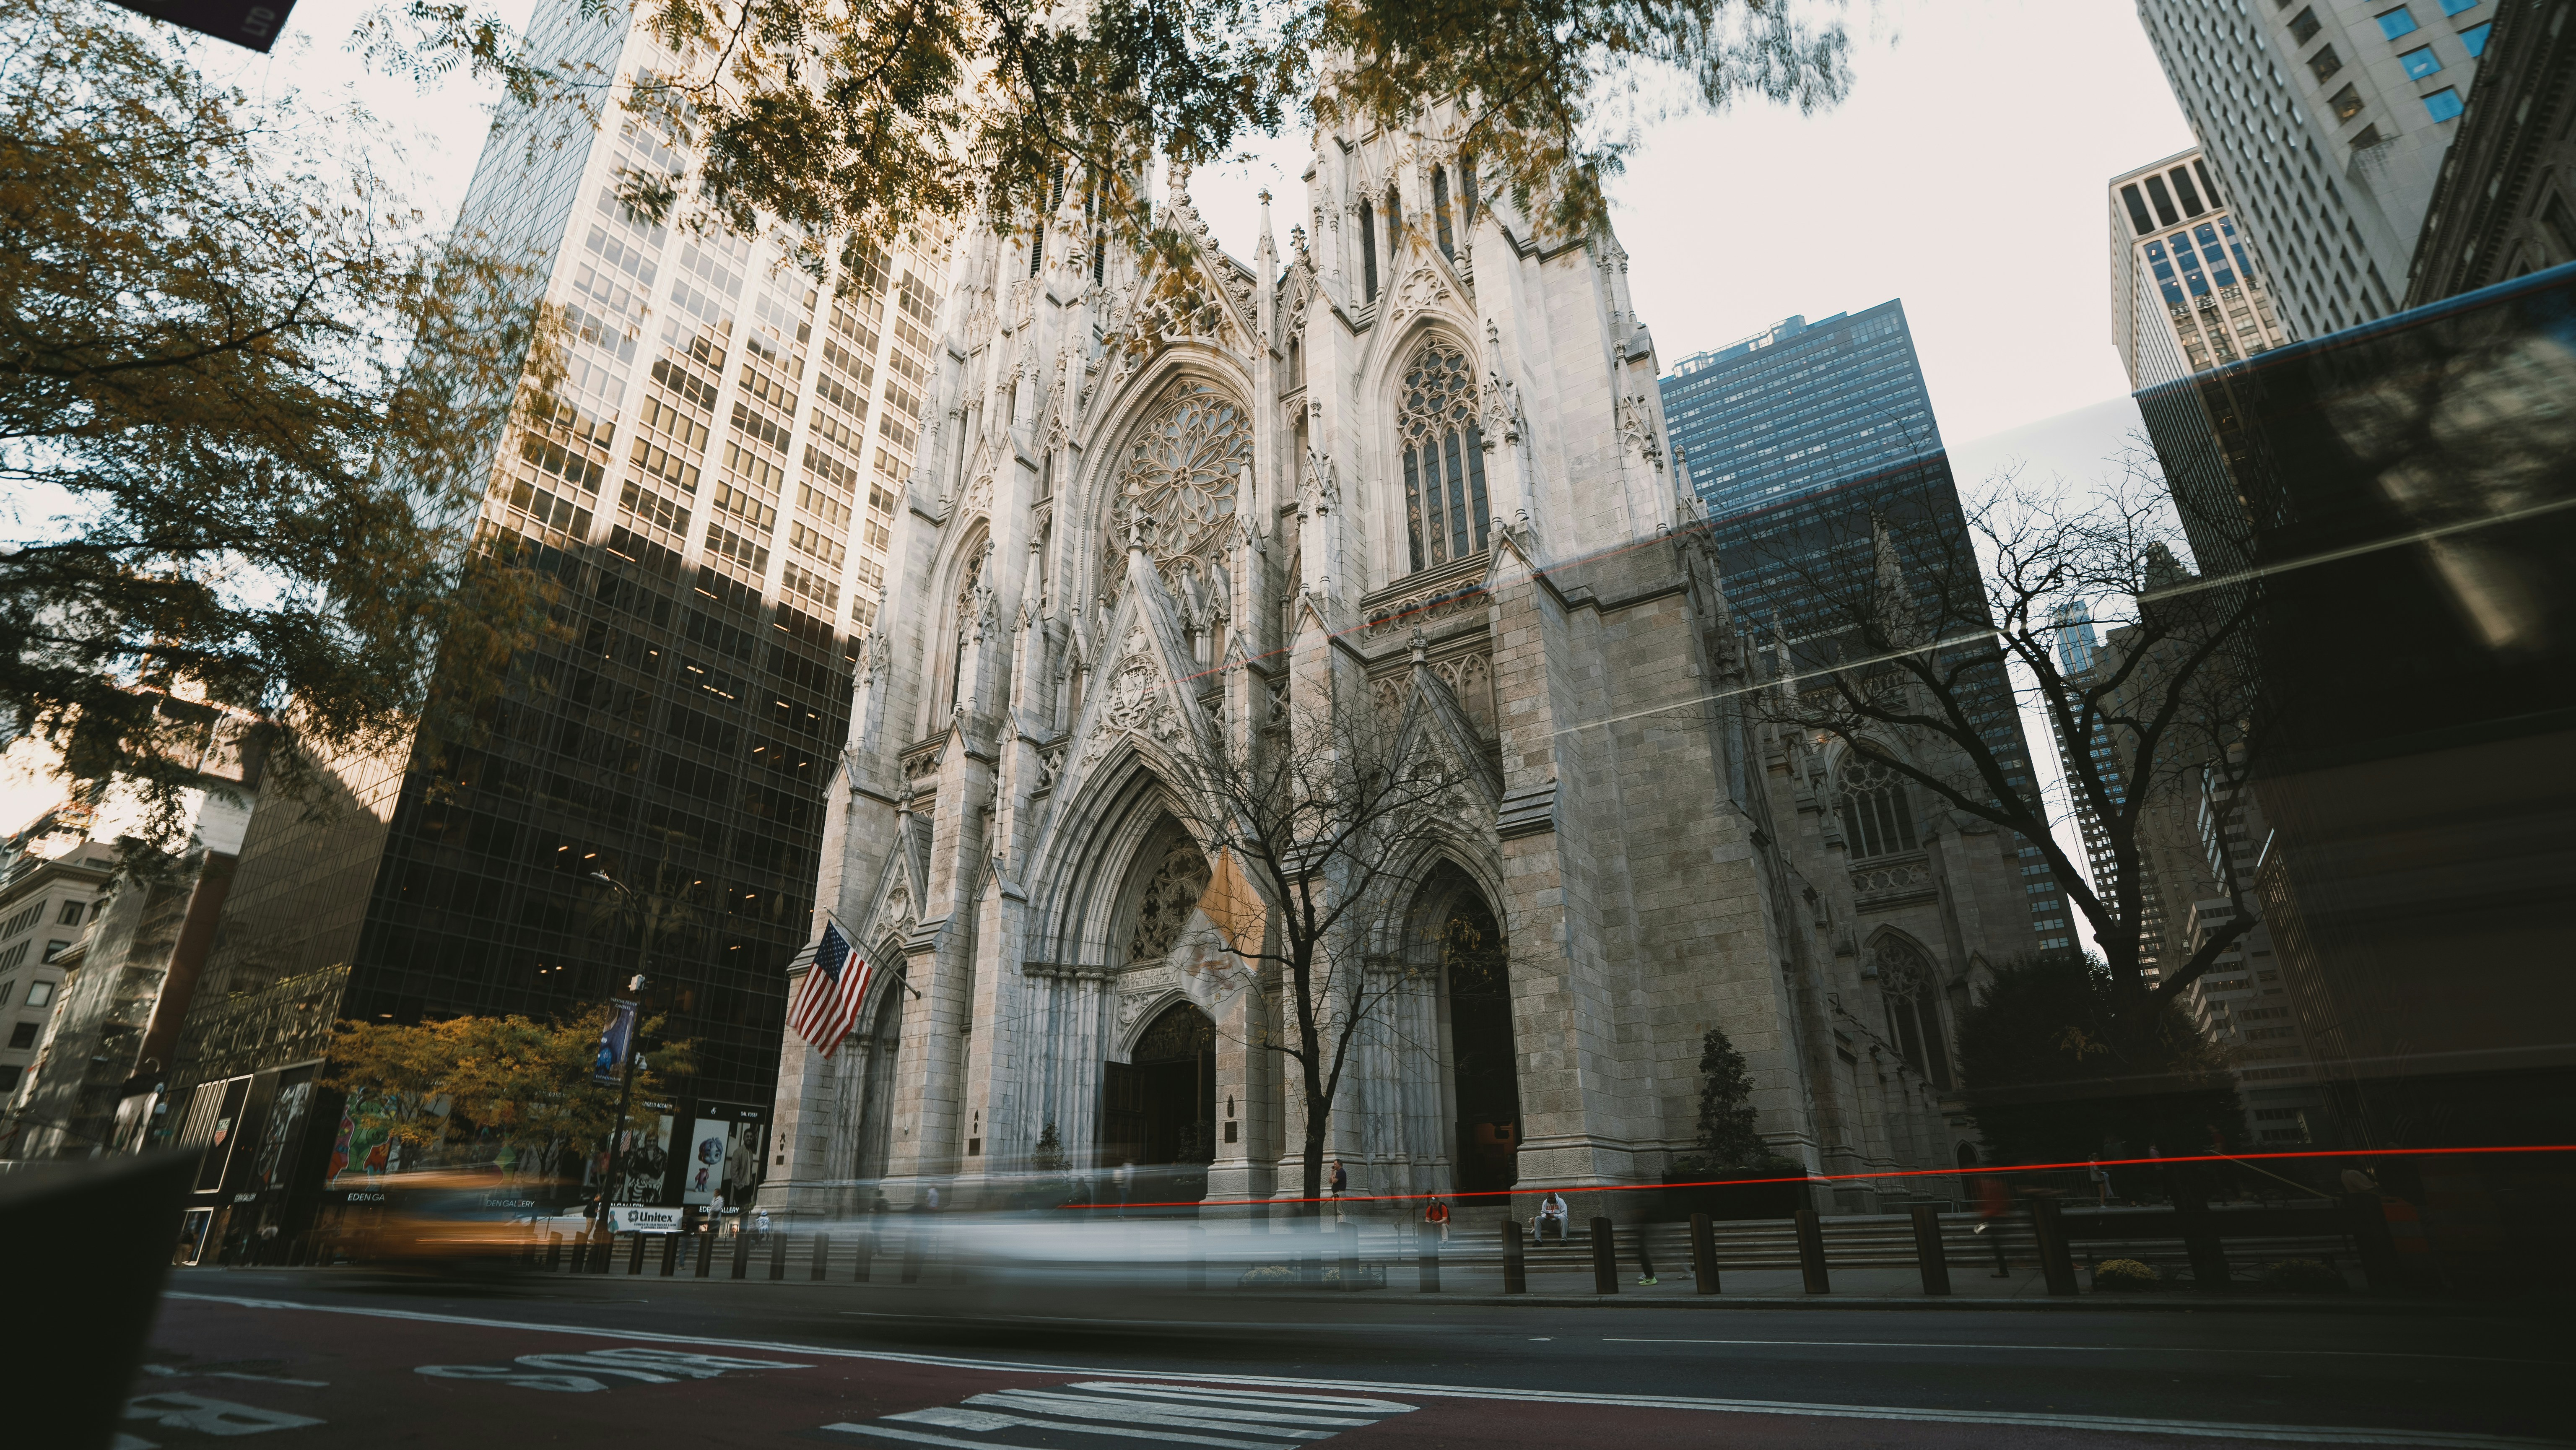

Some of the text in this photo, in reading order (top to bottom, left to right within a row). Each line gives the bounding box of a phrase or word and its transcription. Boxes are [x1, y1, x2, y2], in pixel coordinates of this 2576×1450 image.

[241, 7, 275, 37] LTD
[347, 1193, 371, 1201] EDEN
[640, 1211, 673, 1222] Unitex
